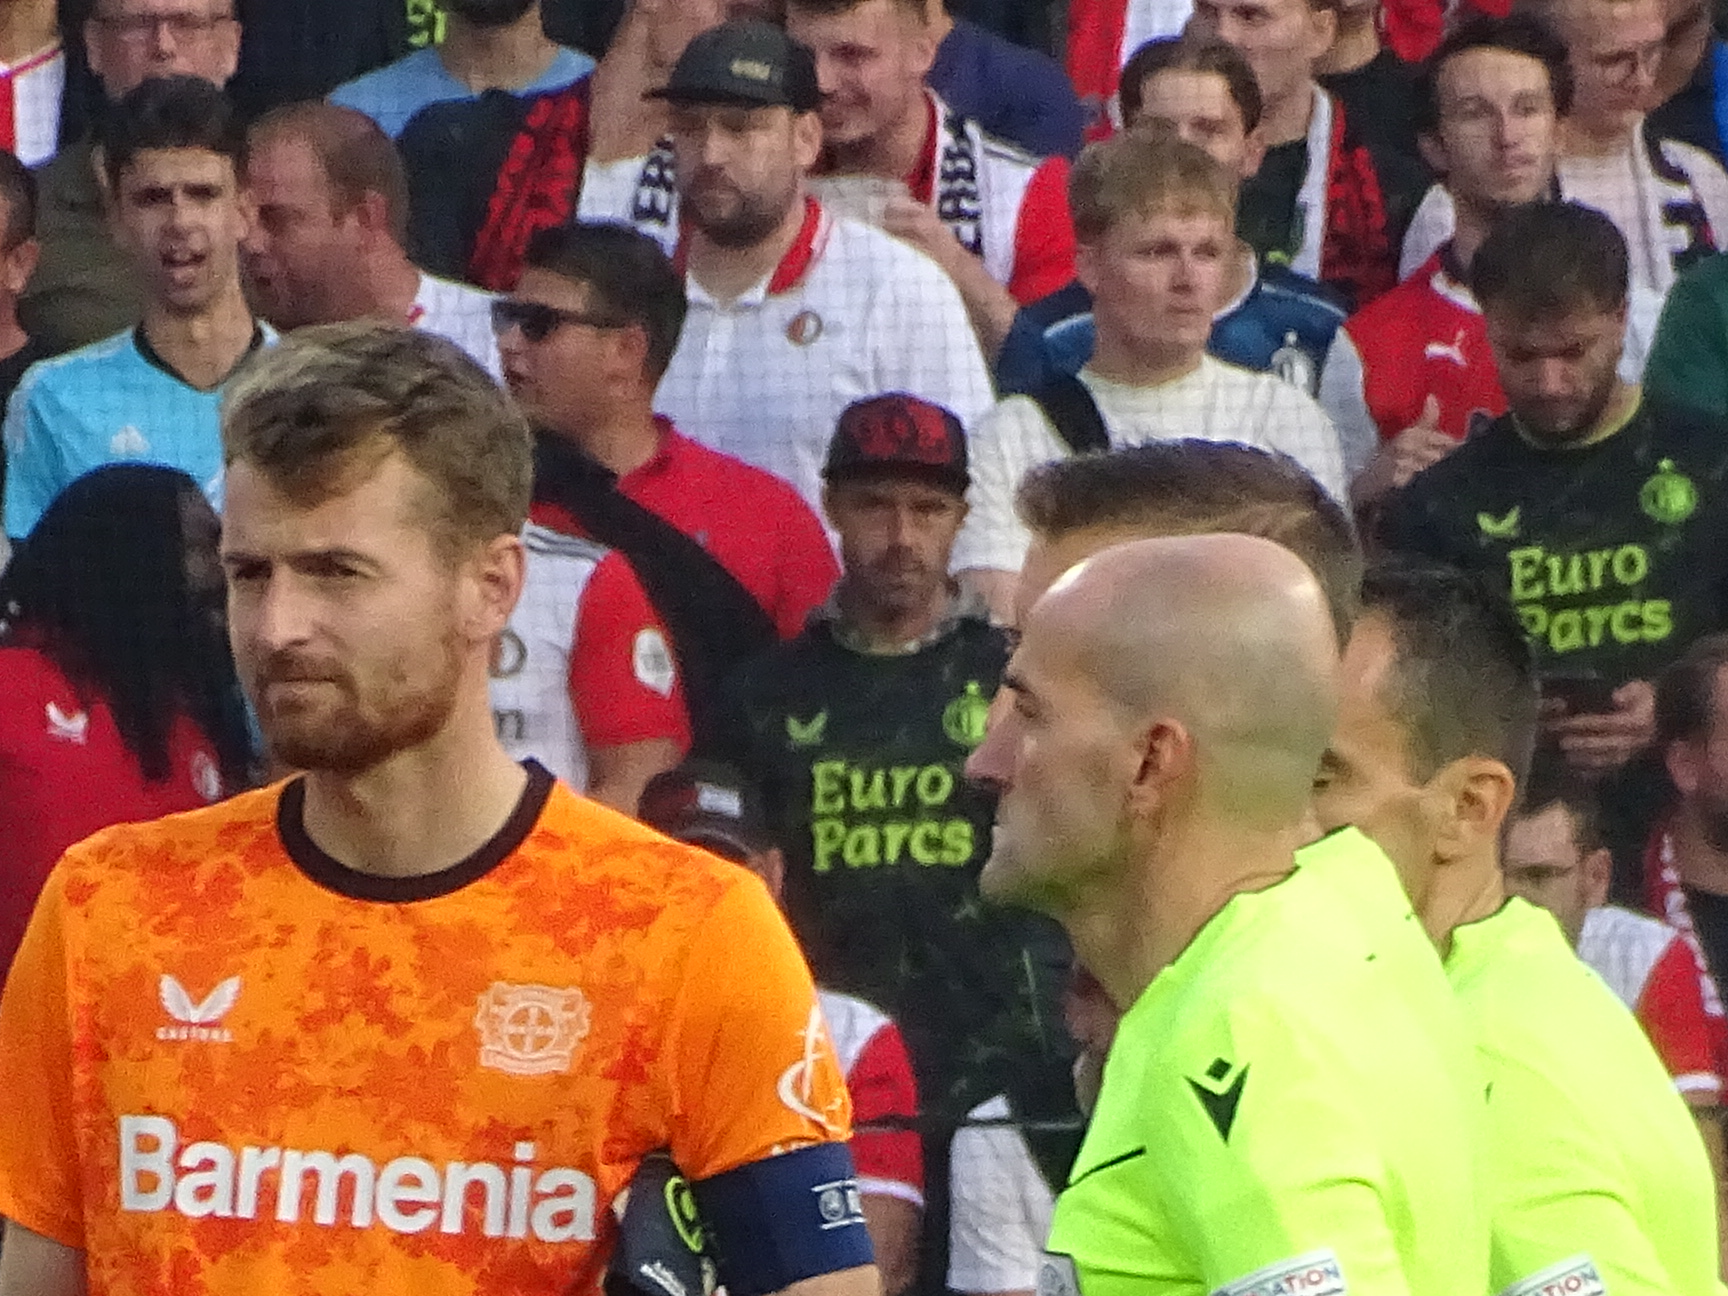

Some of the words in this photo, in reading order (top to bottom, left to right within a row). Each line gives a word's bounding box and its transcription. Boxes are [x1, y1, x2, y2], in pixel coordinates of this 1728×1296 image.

[1508, 543, 1648, 600] Euro
[812, 761, 954, 814] Euro
[811, 817, 974, 872] Parcs
[118, 1114, 597, 1244] Barmenia
